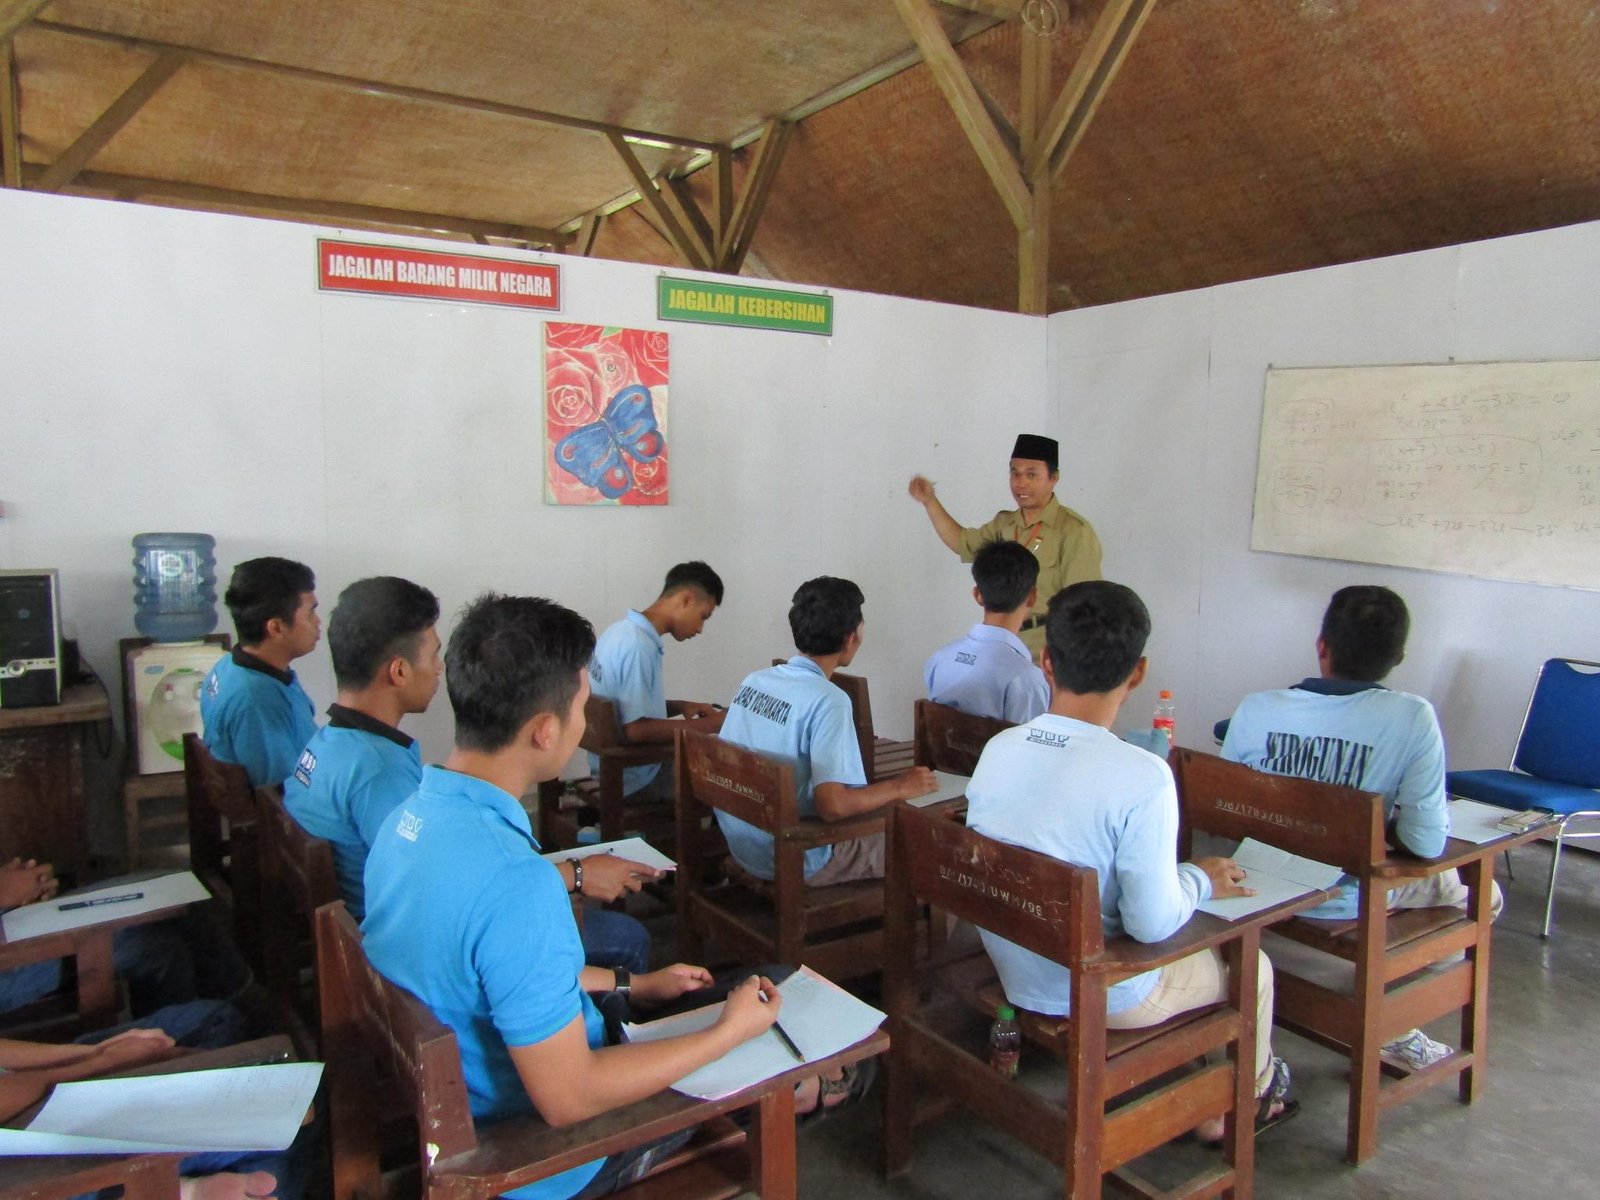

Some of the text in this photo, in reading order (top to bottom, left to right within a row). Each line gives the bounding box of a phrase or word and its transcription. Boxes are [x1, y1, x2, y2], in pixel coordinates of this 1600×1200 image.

[328, 254, 553, 298] JAGALAH BARANG MILIK NEGARA
[668, 288, 826, 324] JAGALAH KEBERSIHAN
